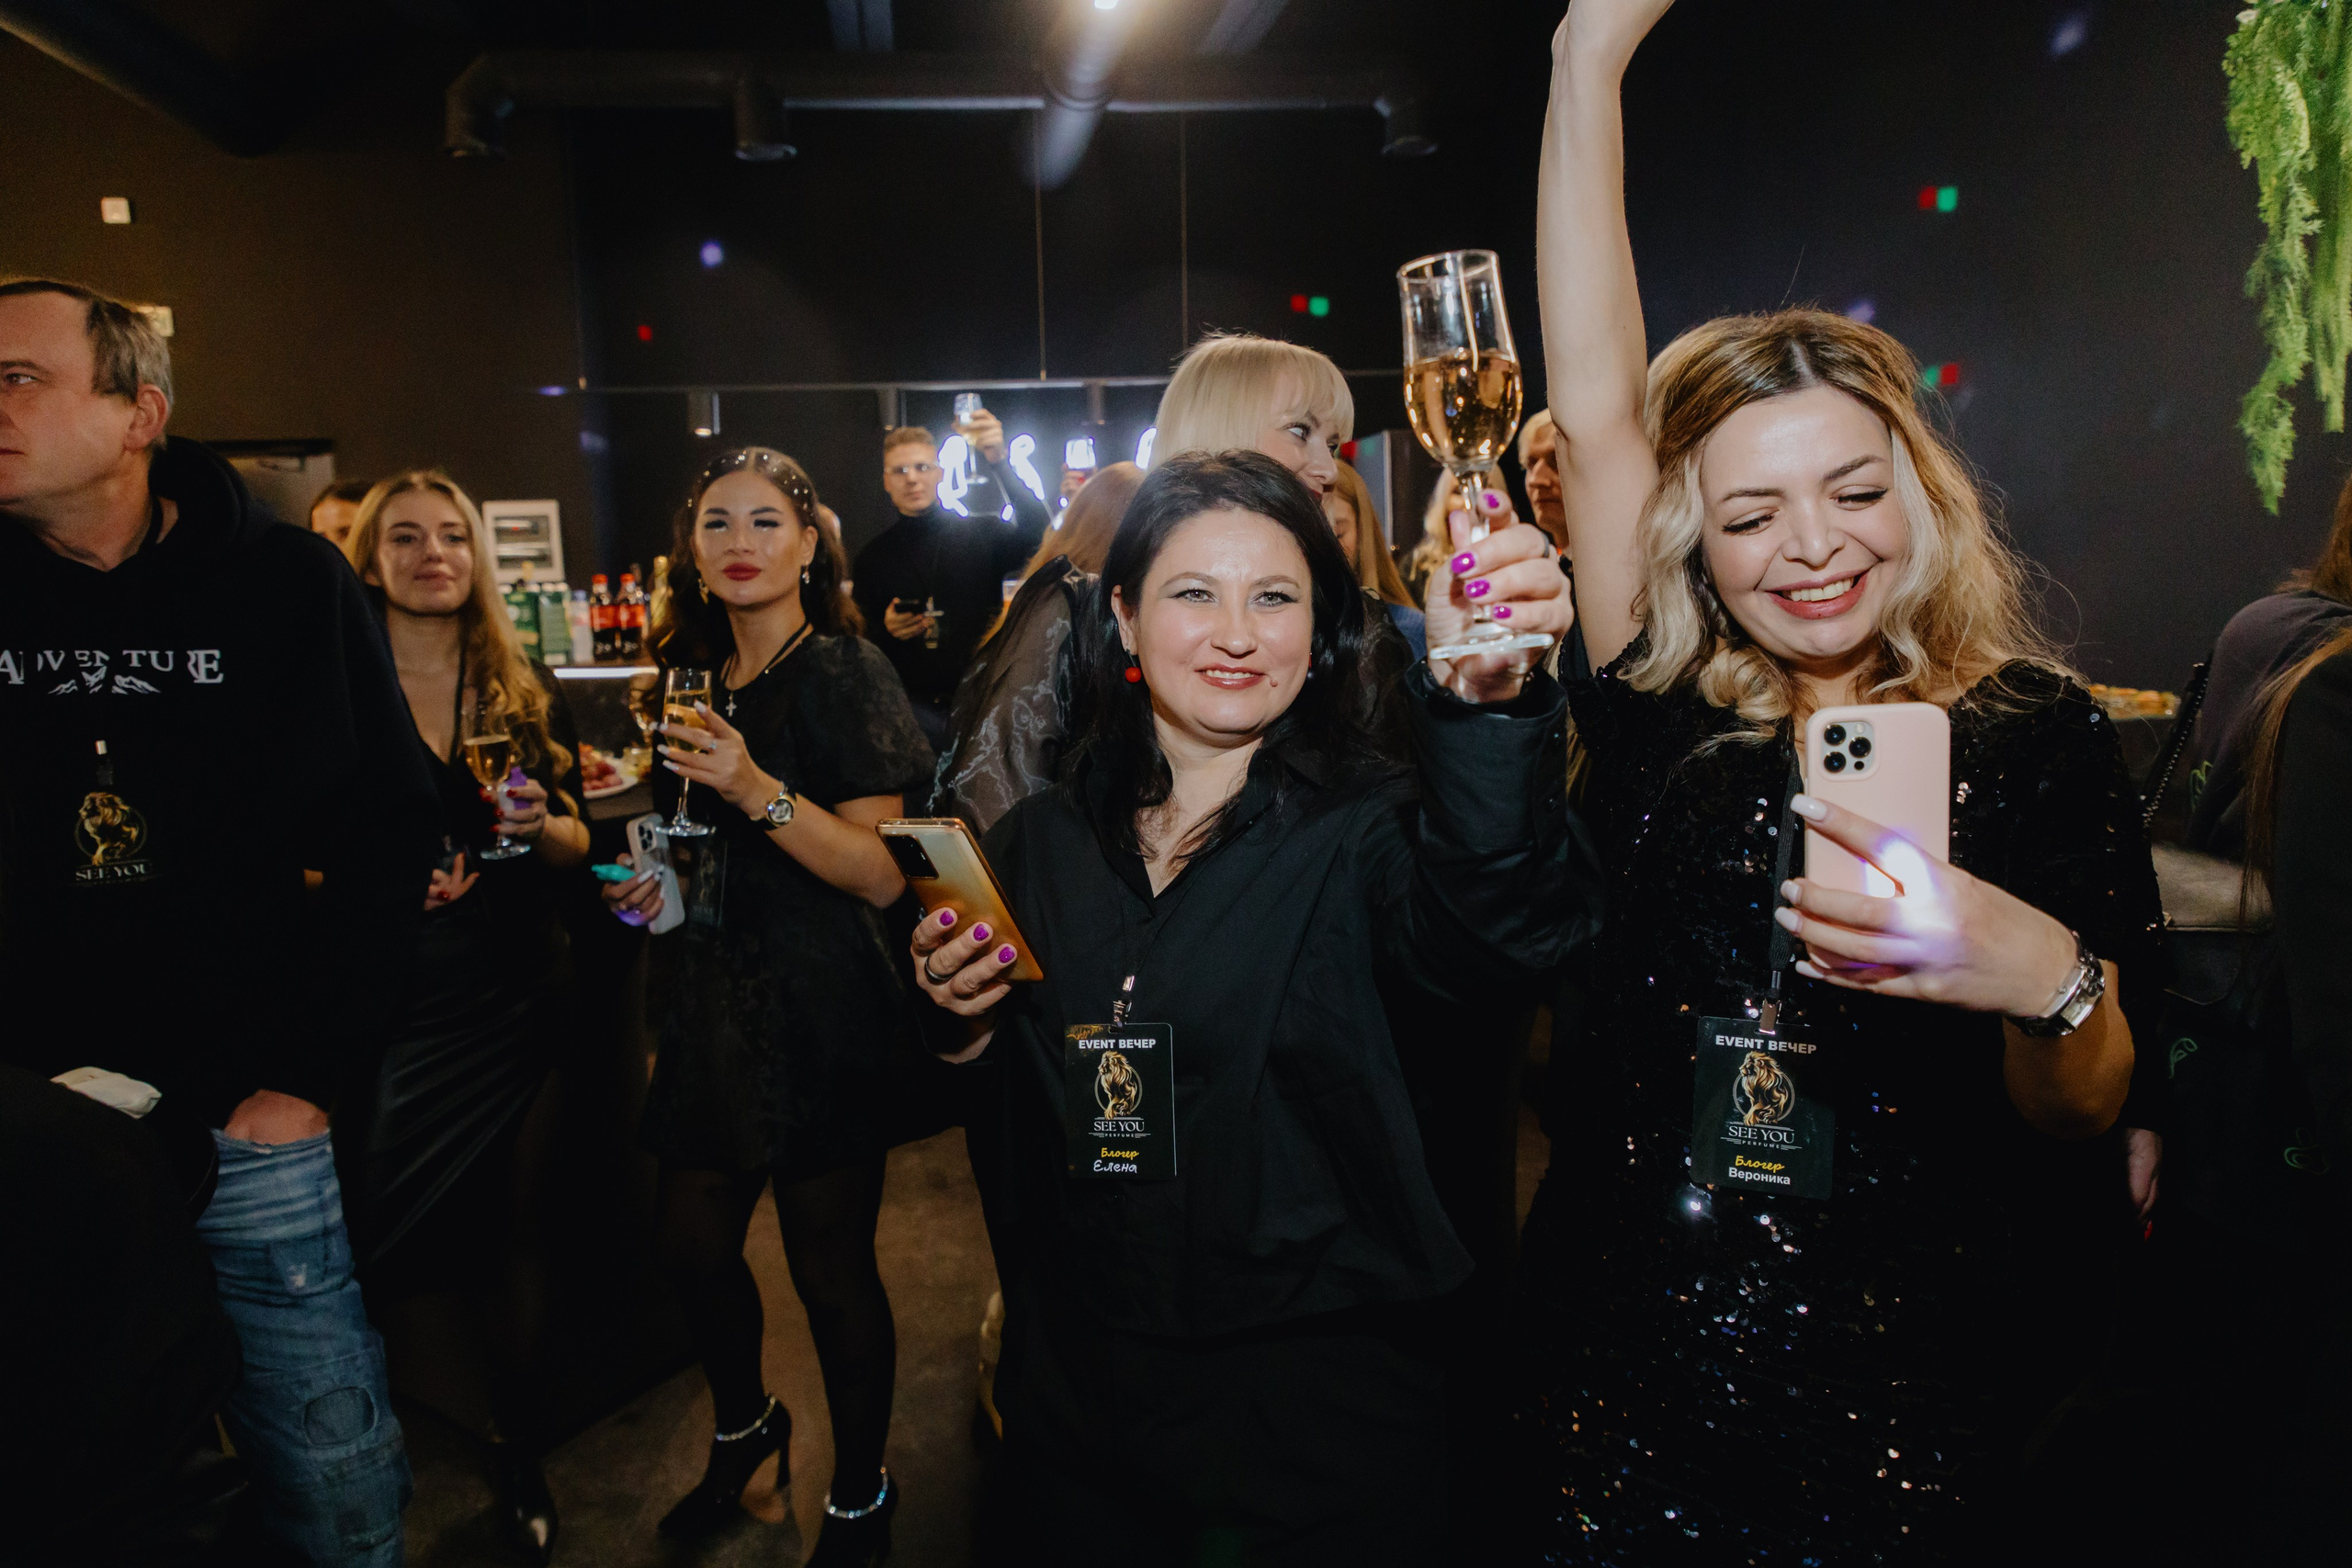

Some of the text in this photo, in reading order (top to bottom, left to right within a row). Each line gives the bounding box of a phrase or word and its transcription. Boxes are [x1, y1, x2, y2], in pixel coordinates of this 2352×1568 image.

[1079, 1039, 1157, 1049] EVENT ВЕЧЕР
[1715, 1035, 1817, 1055] EVENT ВЕЧЕР
[1093, 1121, 1145, 1132] SEE YOU
[1728, 1125, 1795, 1144] SEE YOU
[1742, 1140, 1781, 1149] PERFUME
[1101, 1147, 1139, 1159] Блогер
[1093, 1159, 1137, 1174] Елена
[1735, 1155, 1785, 1173] Блогер
[1728, 1167, 1791, 1185] Вероника
